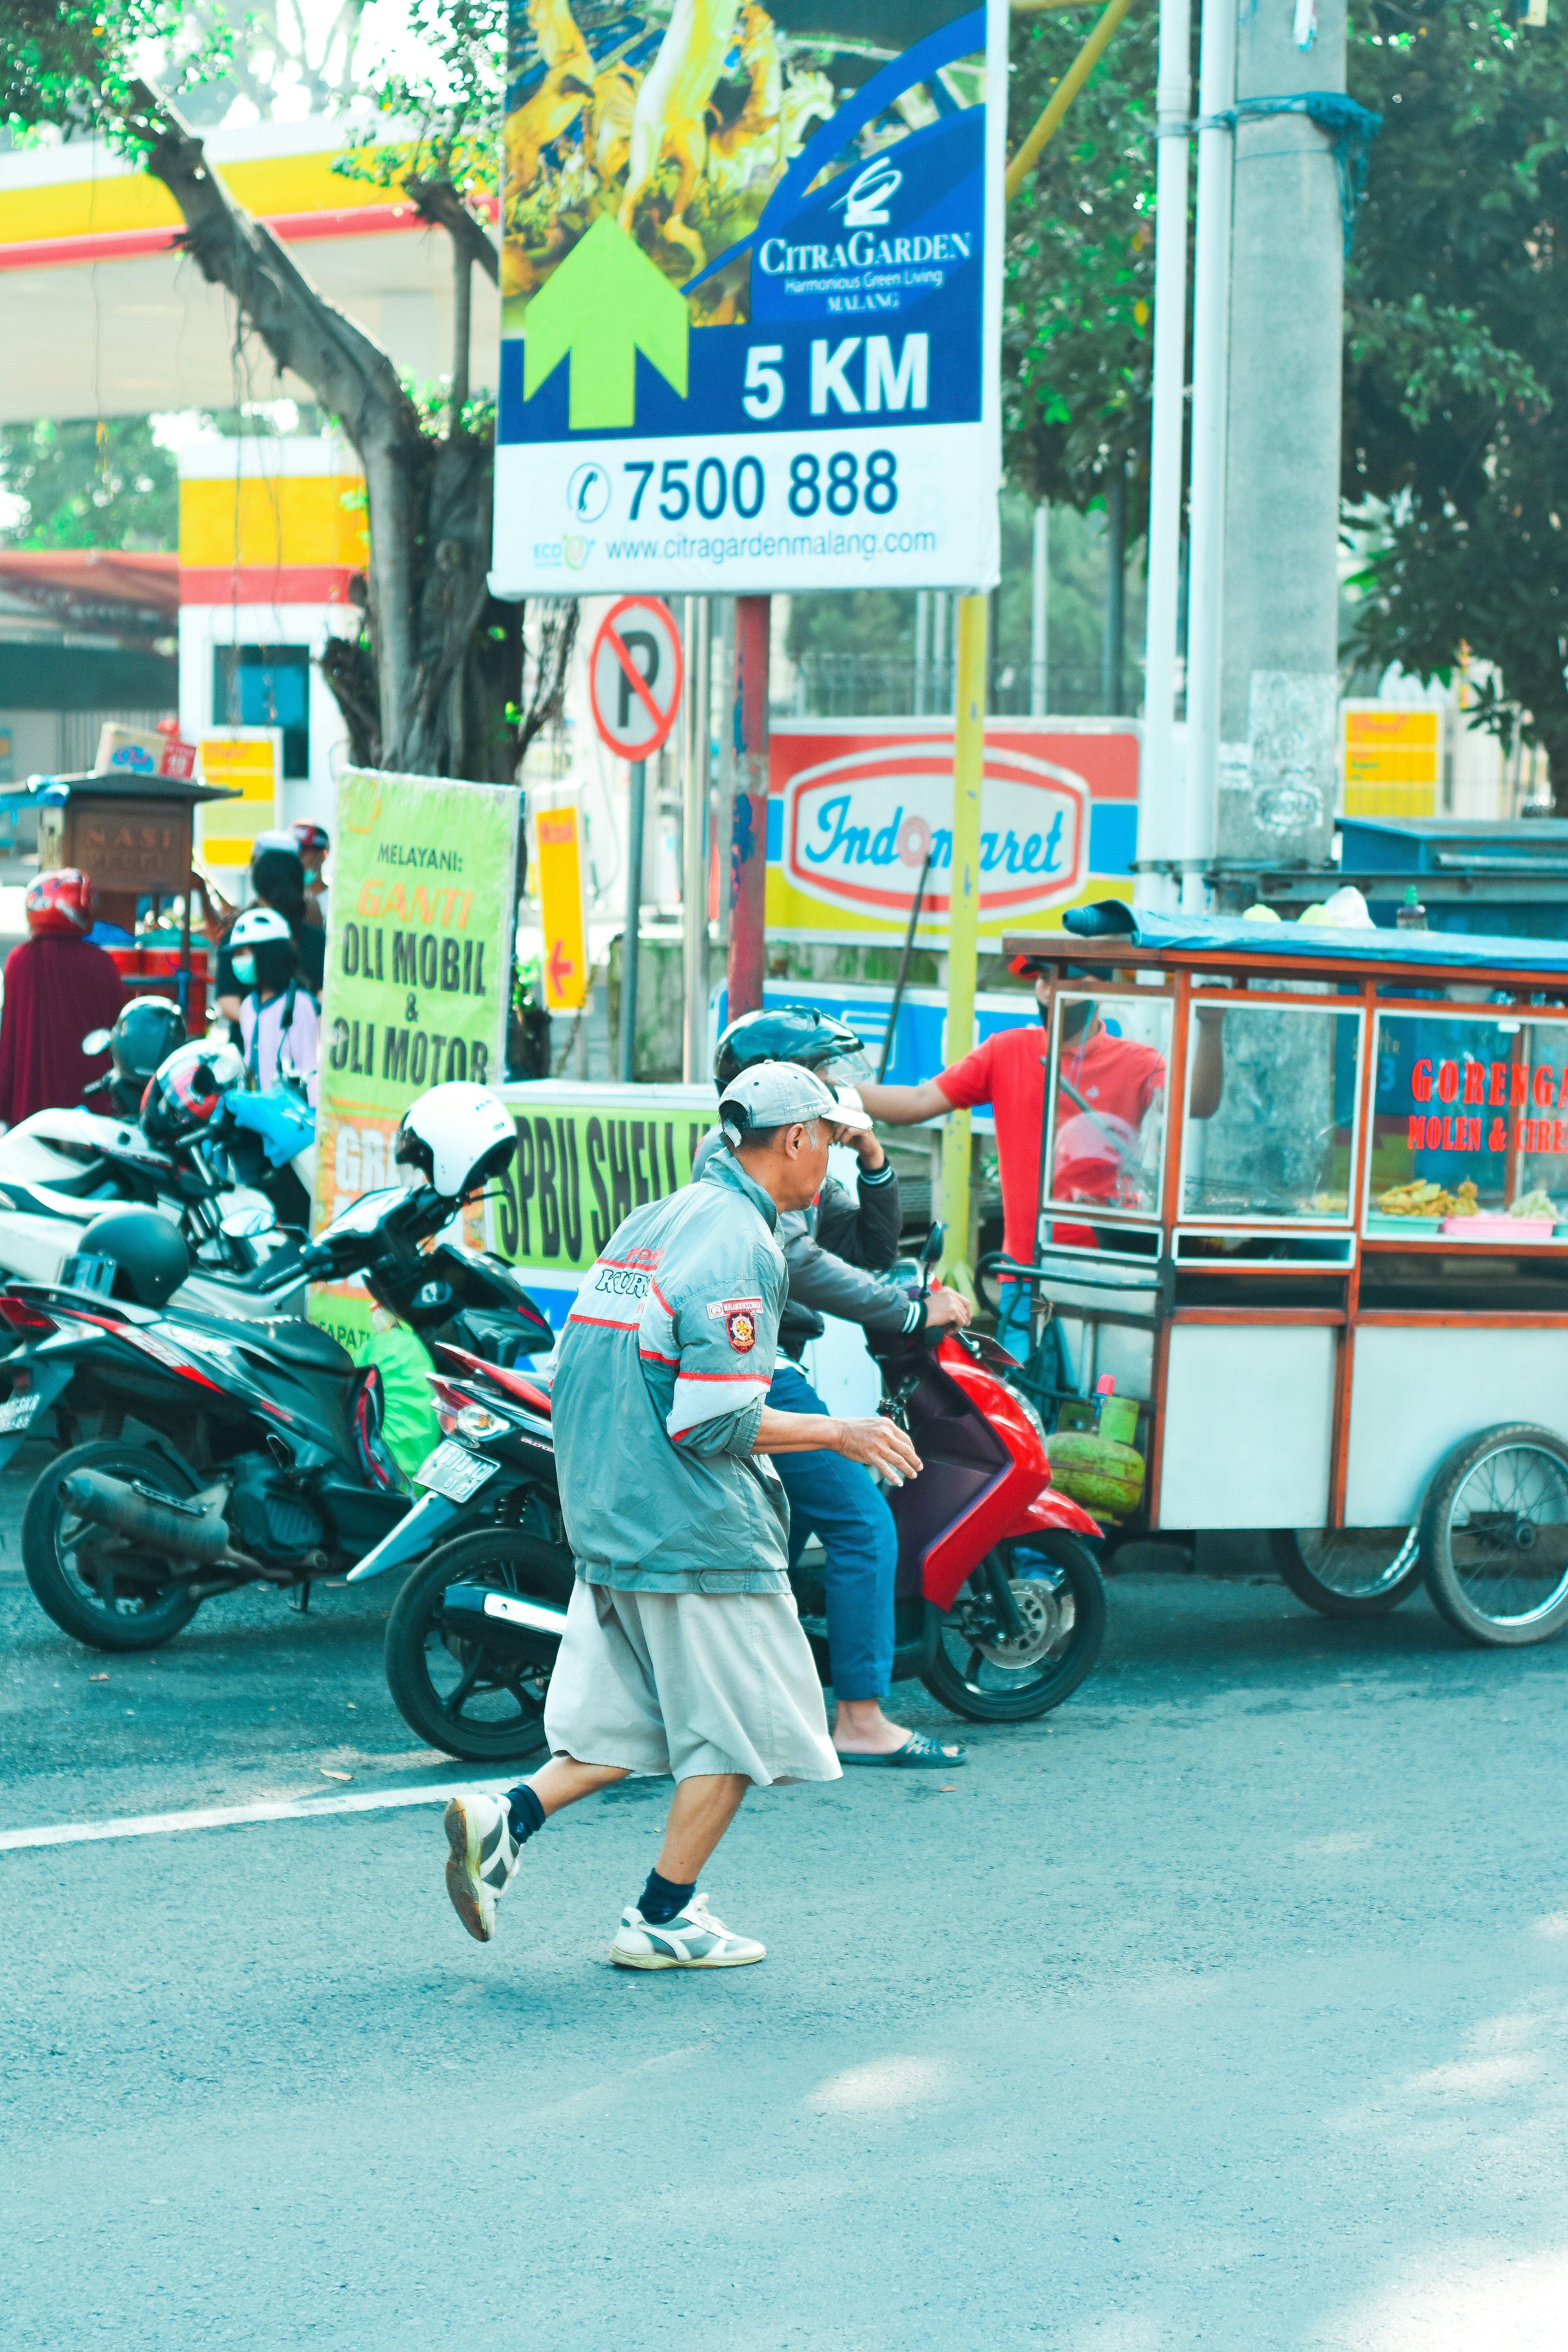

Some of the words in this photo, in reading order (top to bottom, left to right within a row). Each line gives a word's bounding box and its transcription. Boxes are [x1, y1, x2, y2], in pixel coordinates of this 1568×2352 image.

[786, 276, 860, 293] Harmonious
[863, 272, 901, 288] Green
[904, 270, 943, 287] Living
[828, 292, 899, 311] MALANG
[742, 345, 784, 420] 5
[811, 333, 929, 415] KM
[624, 455, 765, 521] 7500
[788, 449, 898, 517] 888
[606, 529, 936, 564] www.citragardenmalang.com
[377, 842, 463, 872] MELAYANI:
[358, 879, 474, 928] GANTI
[342, 921, 384, 980] OLI
[392, 929, 487, 996] MOBIL
[405, 991, 419, 1023] &
[330, 1015, 374, 1076] OLI
[383, 1025, 488, 1085] MOTOR
[1406, 1114, 1483, 1152] MOLEN
[1488, 1116, 1508, 1152] &
[1514, 1118, 1568, 1153] CIRE
[499, 1115, 582, 1263] SPBU
